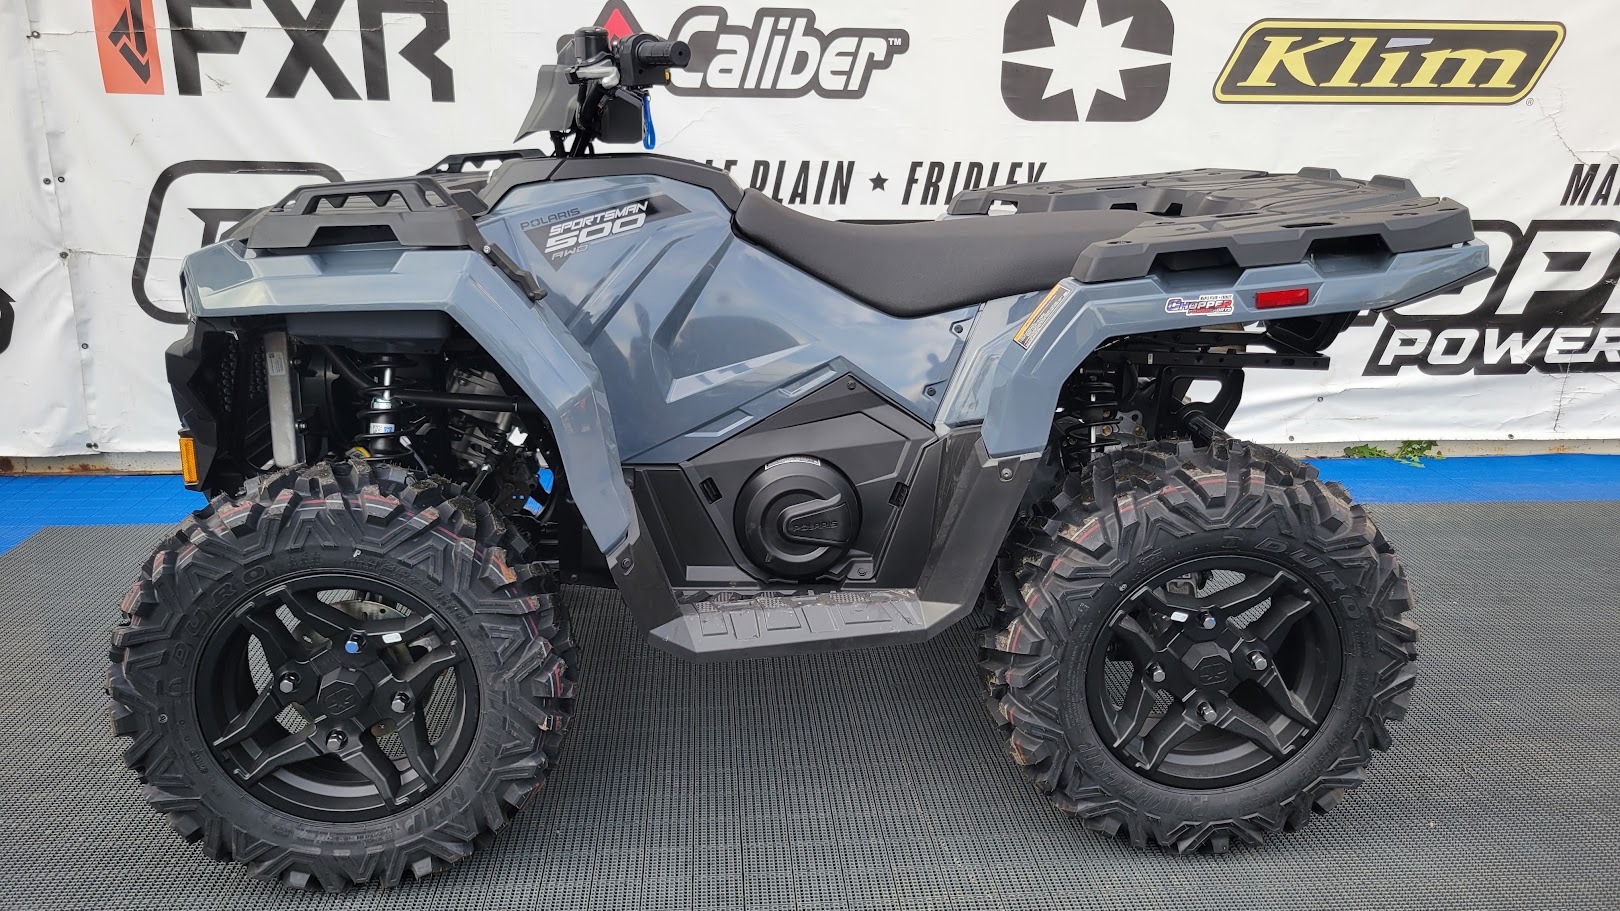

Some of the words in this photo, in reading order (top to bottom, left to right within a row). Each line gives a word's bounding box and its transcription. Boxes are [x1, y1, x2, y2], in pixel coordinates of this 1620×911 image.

[165, 0, 456, 103] FXR
[671, 14, 888, 91] Caliber
[1236, 36, 1528, 88] Klim
[749, 159, 856, 205] PLAIN
[1559, 163, 1620, 206] MA
[520, 208, 581, 231] POLARIS
[544, 212, 647, 254] 500
[549, 200, 649, 237] SPORTSMAN
[551, 244, 589, 261] AWD
[1168, 298, 1231, 311] CHOPPER
[793, 520, 838, 533] POLARIS
